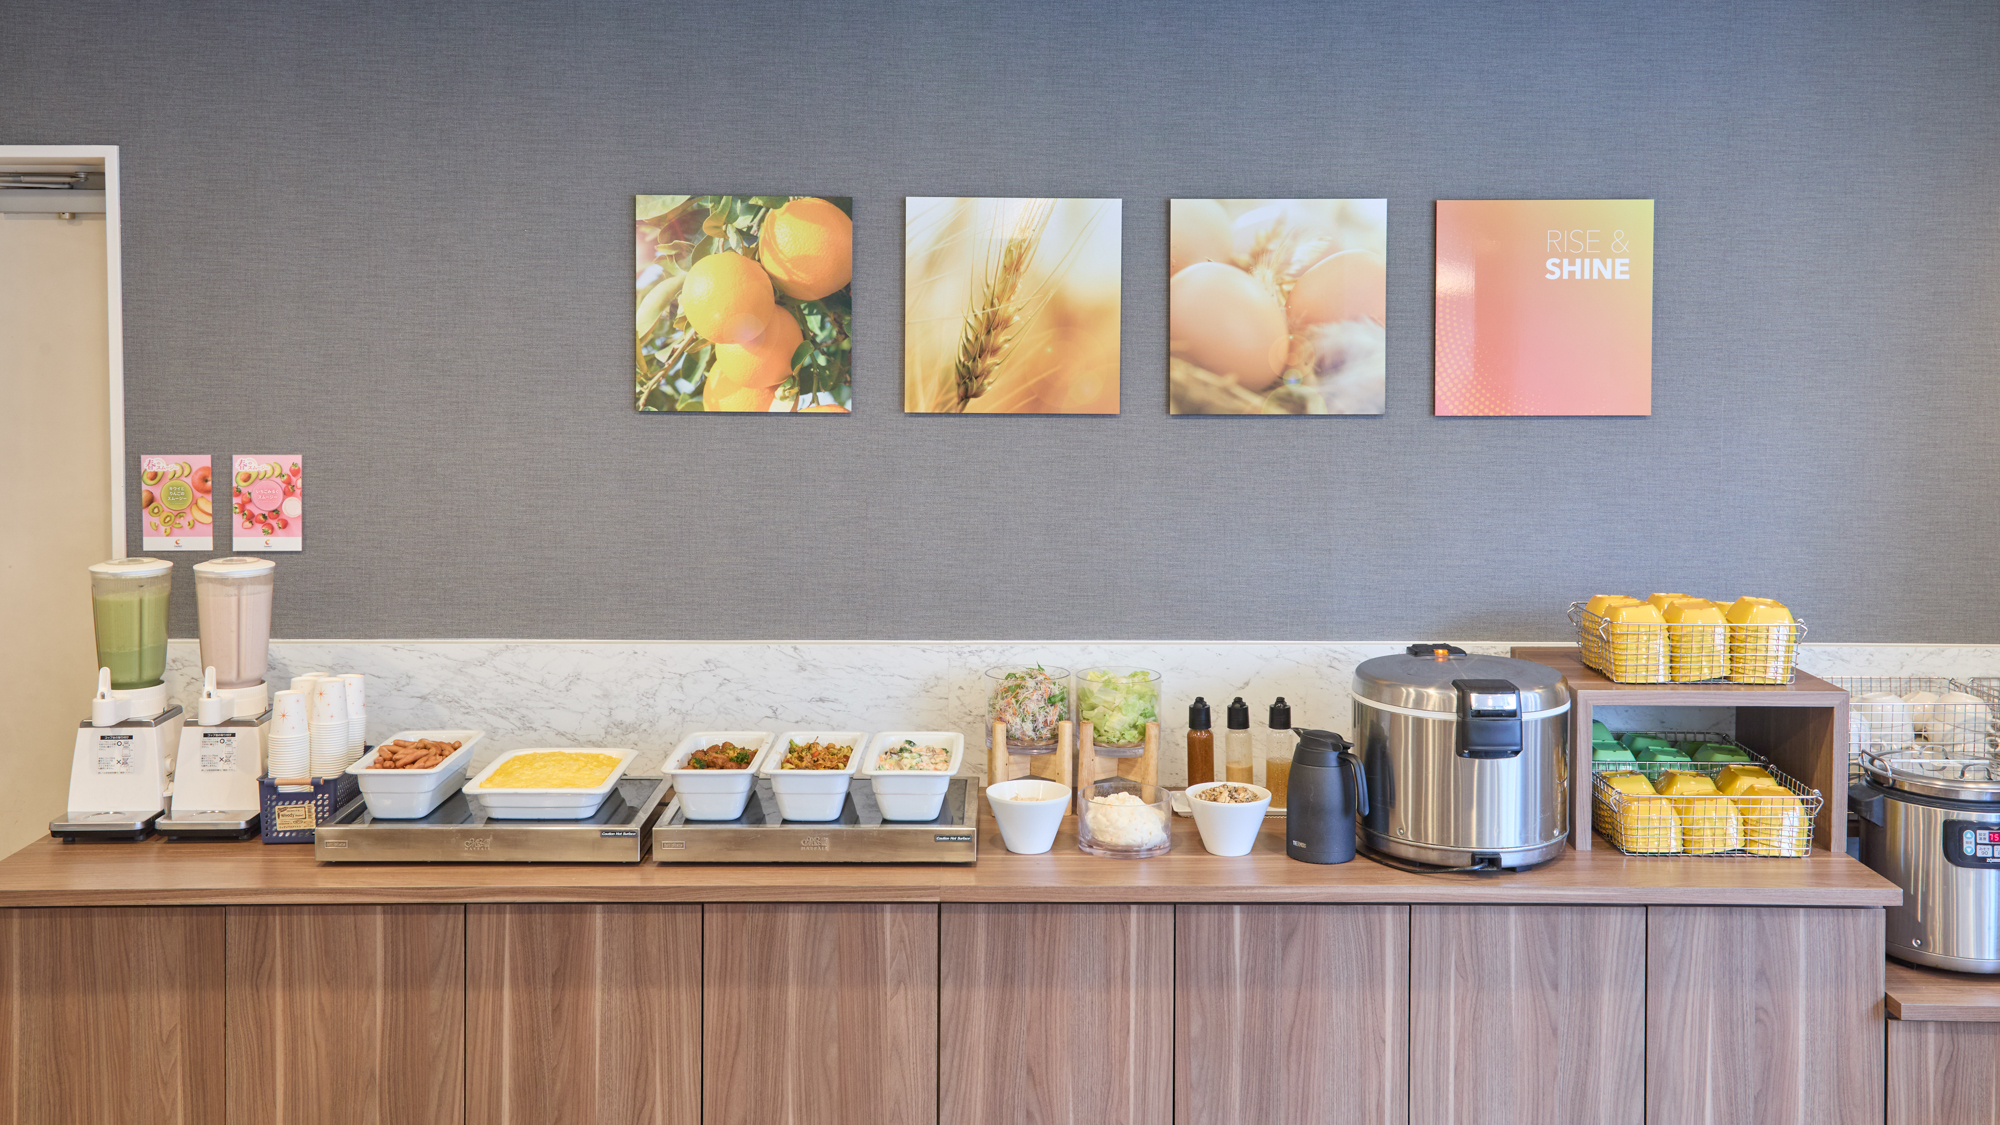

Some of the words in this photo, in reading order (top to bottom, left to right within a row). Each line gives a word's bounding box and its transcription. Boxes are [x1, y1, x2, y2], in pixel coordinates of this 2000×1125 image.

[1547, 229, 1600, 253] RISE
[1611, 229, 1629, 253] &
[1545, 257, 1630, 280] SHINE
